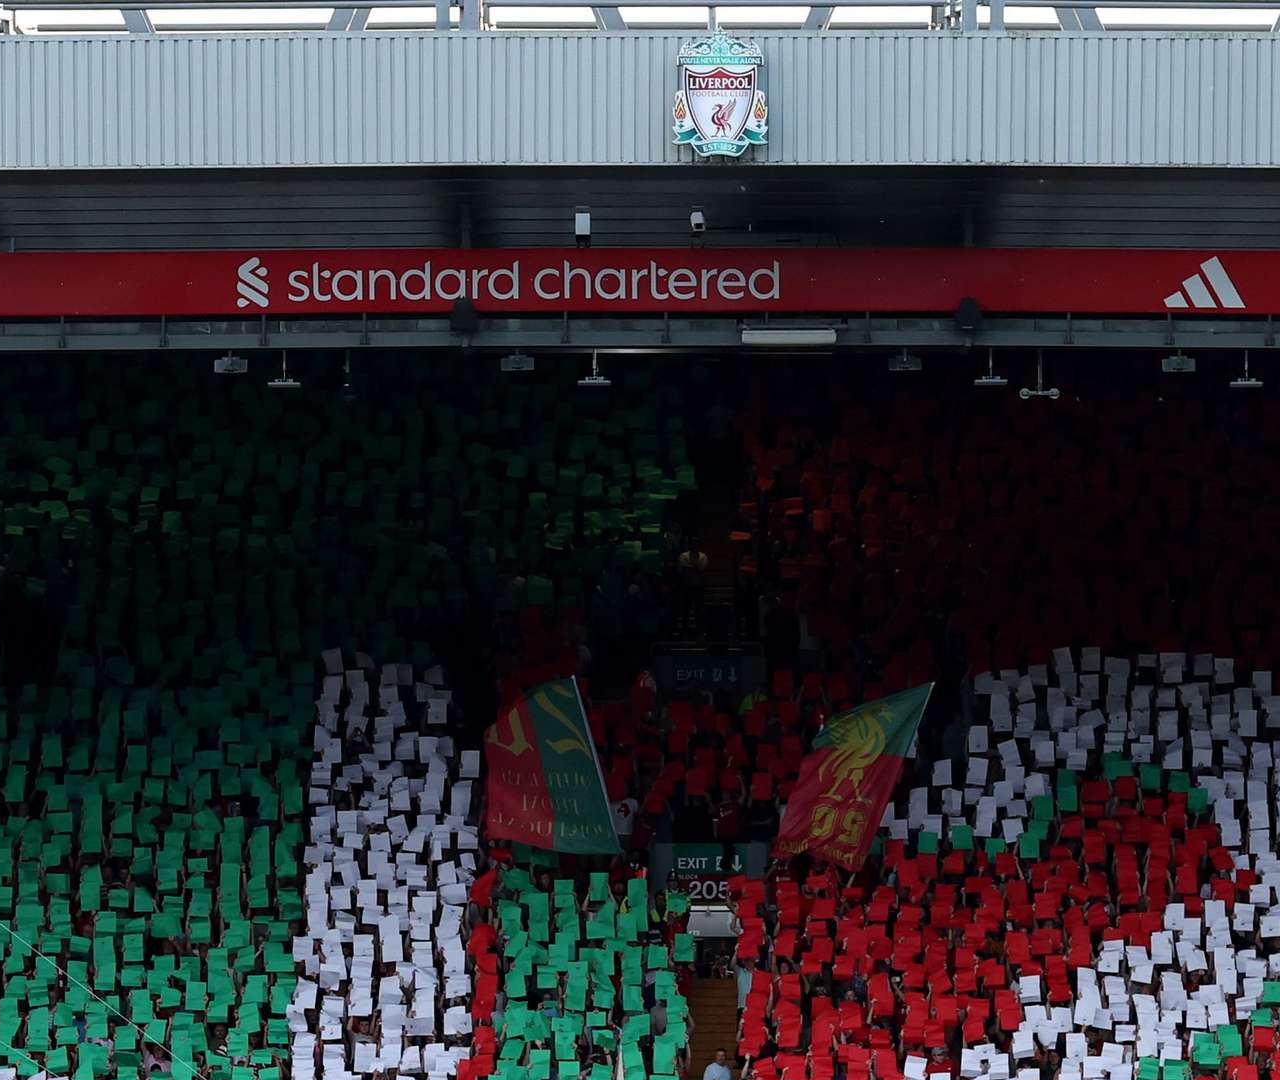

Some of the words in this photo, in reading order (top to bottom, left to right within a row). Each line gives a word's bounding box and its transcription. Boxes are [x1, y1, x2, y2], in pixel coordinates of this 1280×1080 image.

[689, 77, 751, 89] LIVERPOOL
[288, 260, 519, 303] standard
[533, 259, 781, 302] chartered
[677, 857, 708, 869] EXIT
